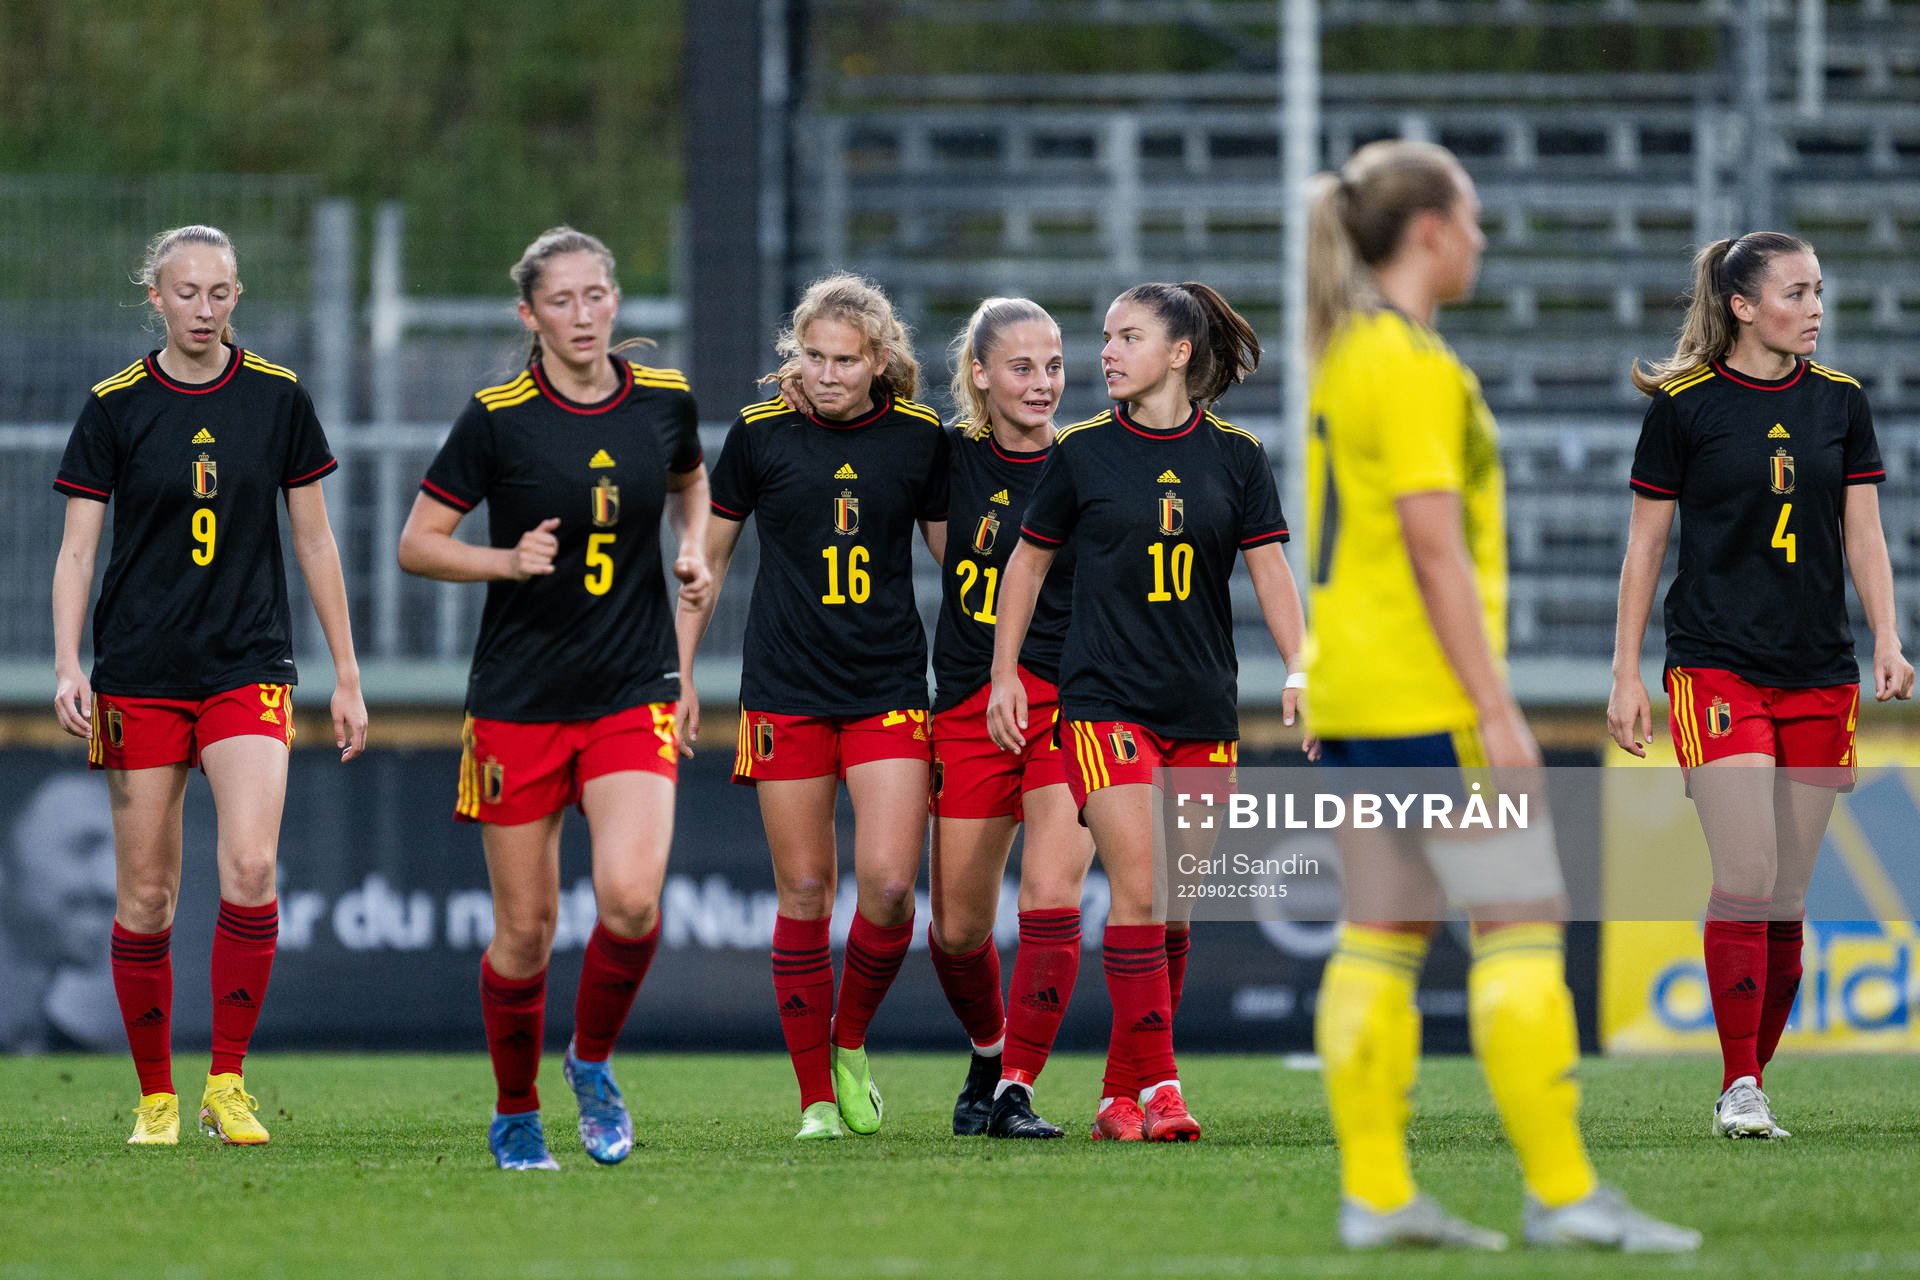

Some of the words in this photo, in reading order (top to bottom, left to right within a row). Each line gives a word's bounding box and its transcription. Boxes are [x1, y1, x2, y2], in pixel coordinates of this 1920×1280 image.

[191, 507, 216, 566] 9
[1771, 503, 1796, 563] 4
[584, 533, 616, 596] 5
[822, 545, 871, 605] 16
[956, 559, 999, 625] 21
[1147, 542, 1194, 602] 10
[332, 870, 432, 950] du
